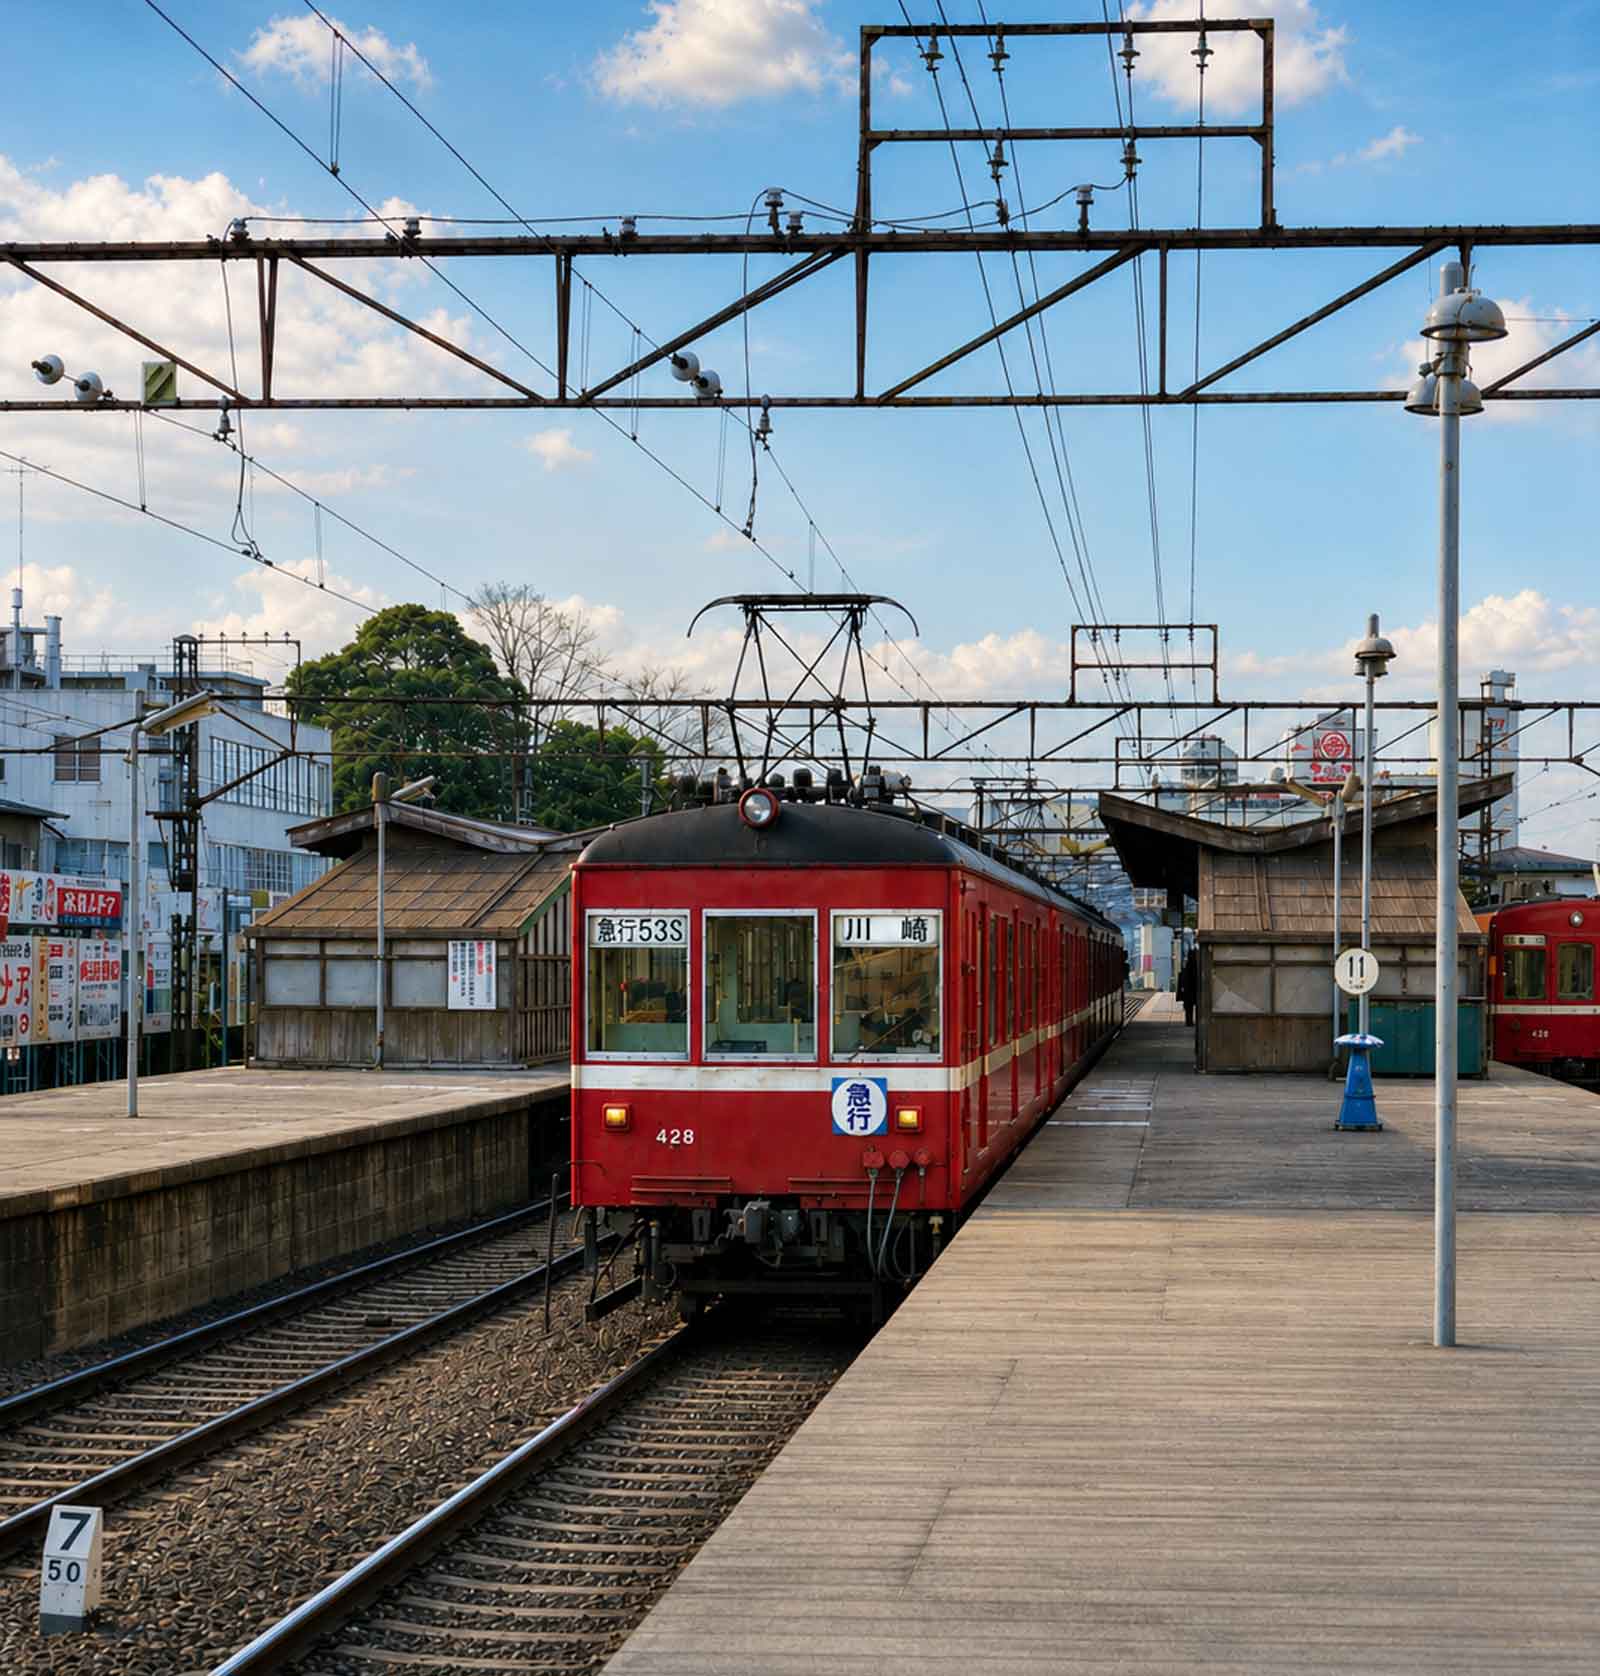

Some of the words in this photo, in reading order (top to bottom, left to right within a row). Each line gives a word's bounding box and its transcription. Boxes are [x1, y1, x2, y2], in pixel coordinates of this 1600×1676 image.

[598, 918, 683, 942] 急行53S
[846, 1083, 872, 1130] 急行
[655, 1128, 694, 1145] 428
[59, 1511, 92, 1551] 7
[48, 1560, 81, 1582] 50
